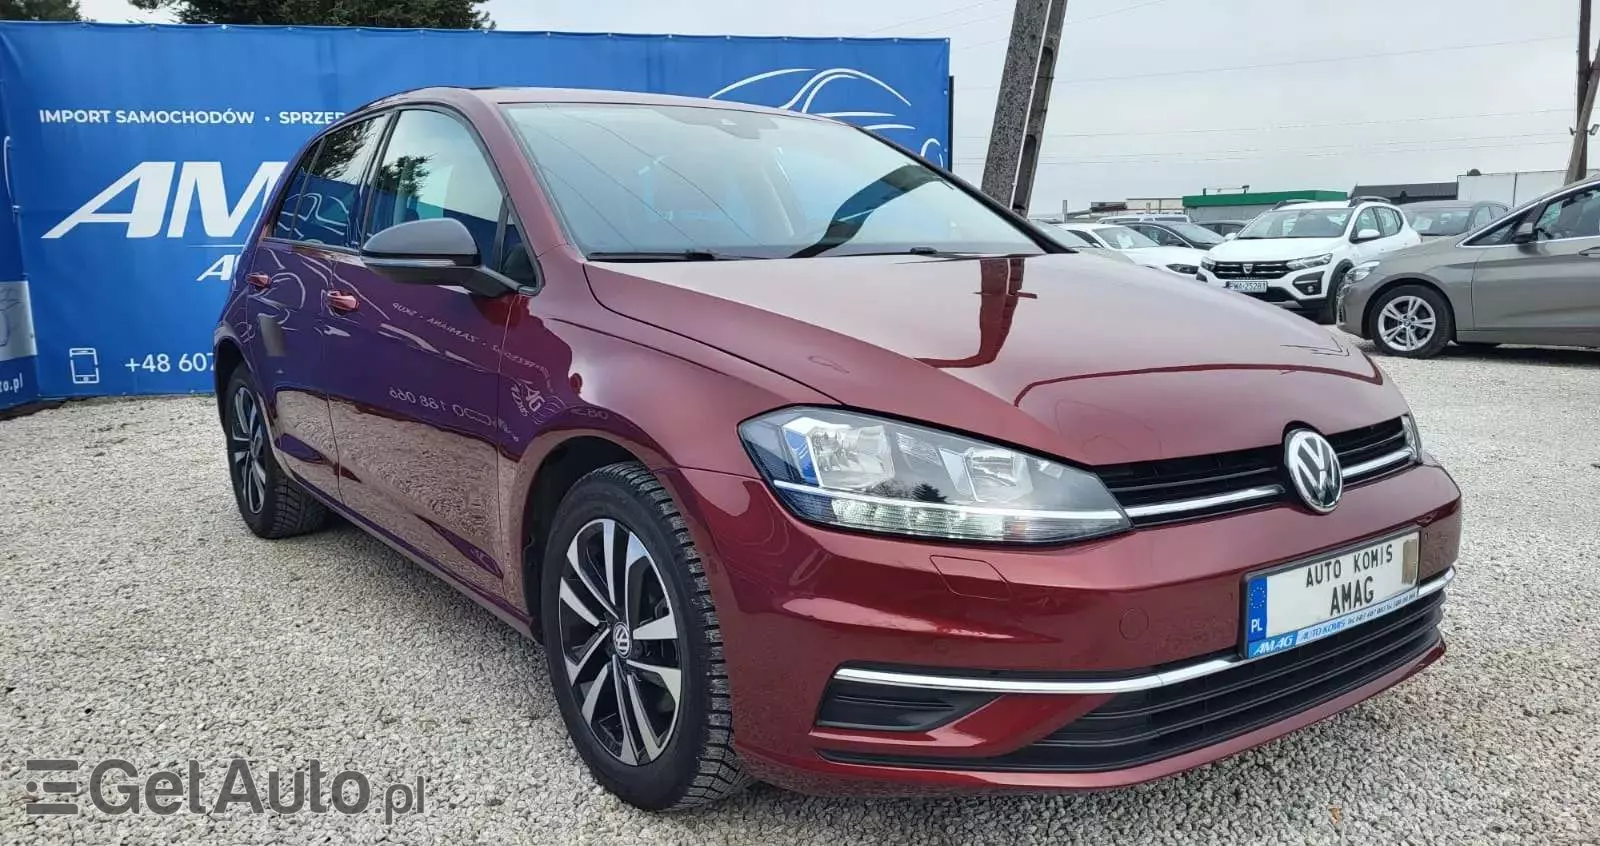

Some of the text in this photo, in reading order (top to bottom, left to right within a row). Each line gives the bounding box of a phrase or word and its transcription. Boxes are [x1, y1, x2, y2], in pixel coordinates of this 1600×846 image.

[39, 109, 111, 124] IMPORT
[115, 107, 255, 125] SAMOCHODÓW
[124, 353, 171, 373] +48
[1306, 543, 1393, 589] AUTO KOMIS
[1330, 575, 1375, 617] AMAG
[1251, 618, 1264, 634] PL
[1254, 635, 1294, 655] AMAG
